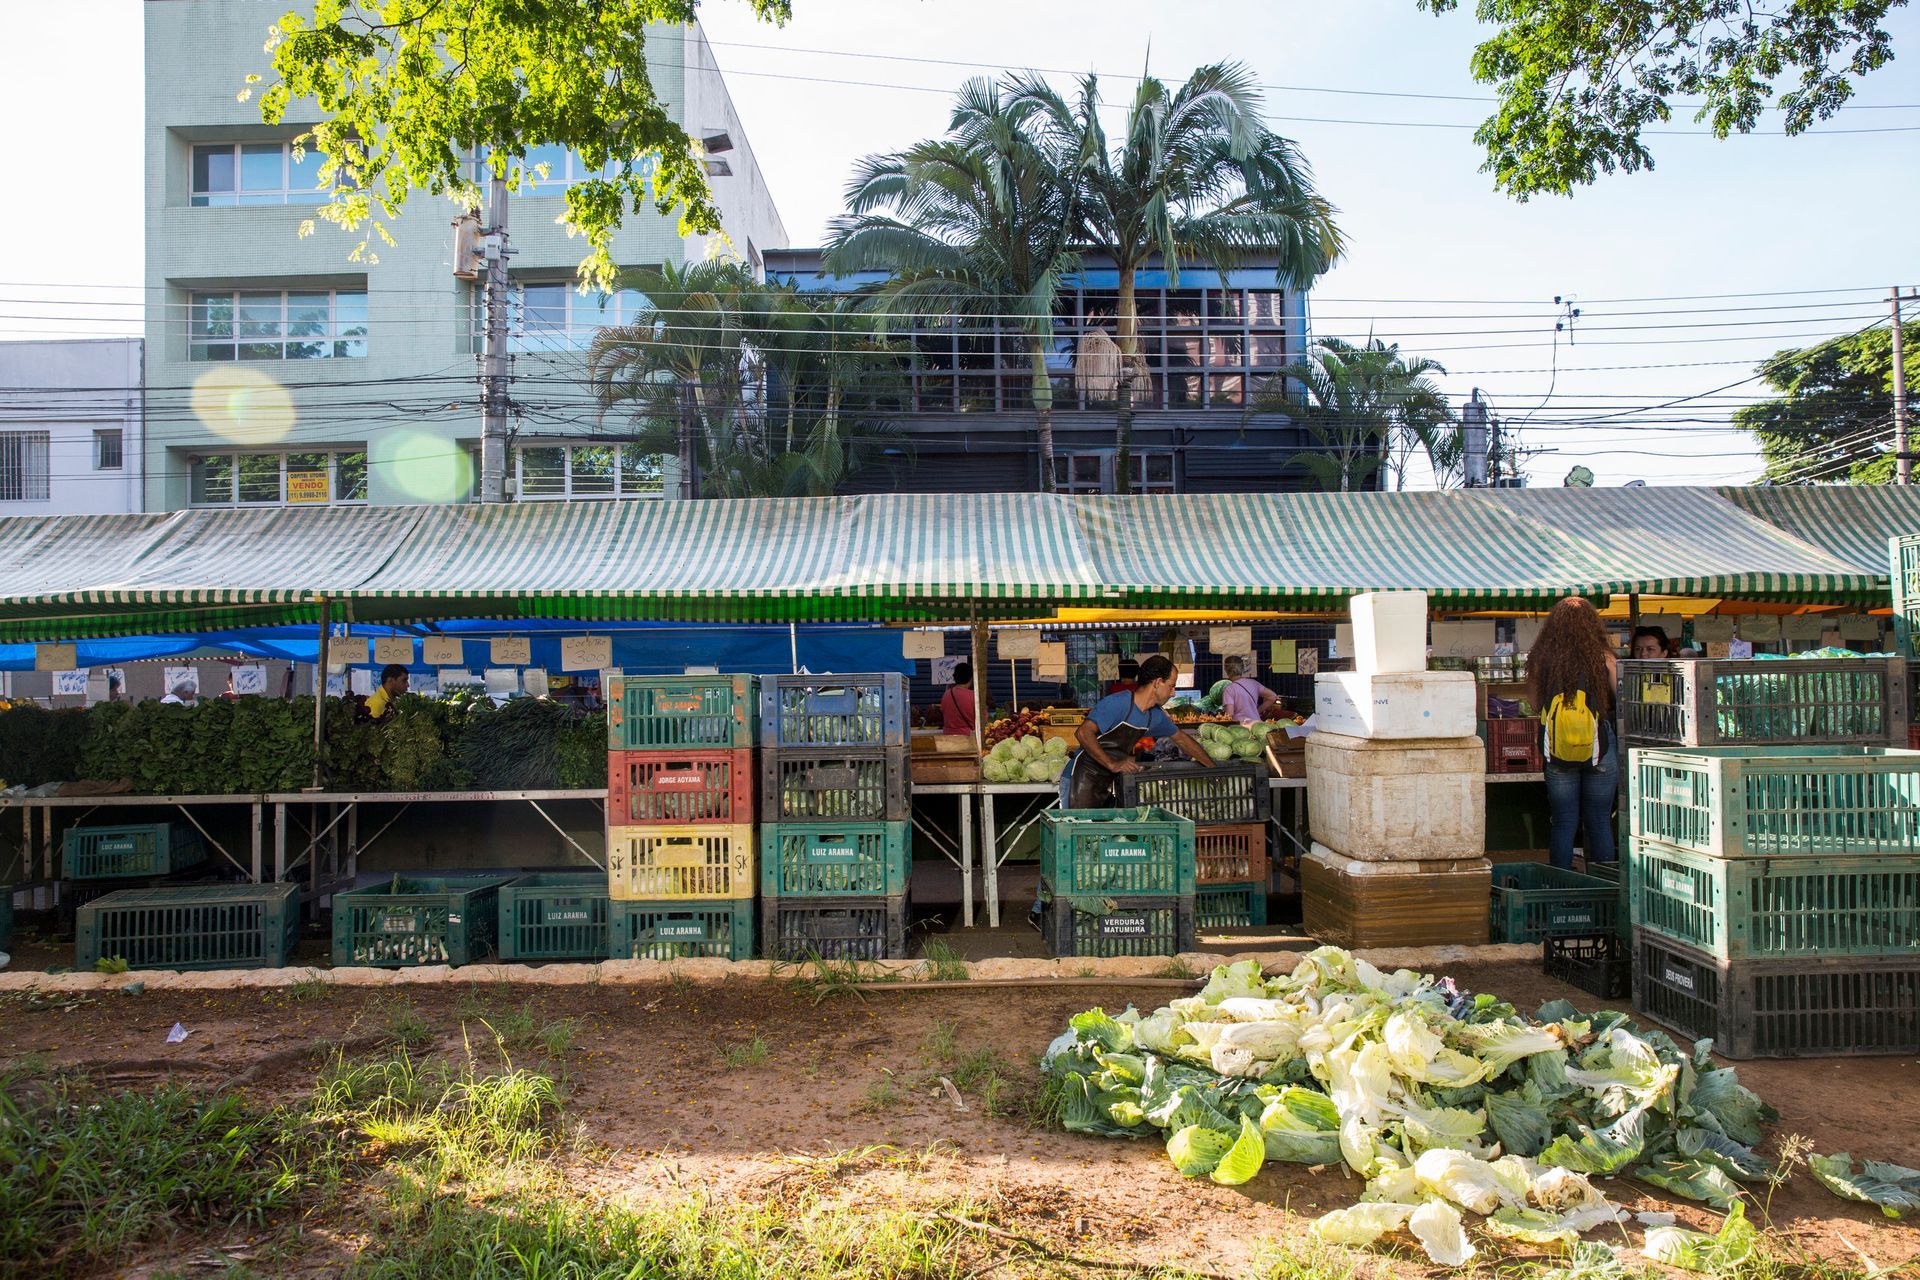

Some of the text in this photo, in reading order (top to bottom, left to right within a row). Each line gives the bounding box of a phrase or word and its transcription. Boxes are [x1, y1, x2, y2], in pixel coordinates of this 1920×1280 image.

[380, 645, 412, 659] 300
[917, 644, 938, 653] 300
[340, 650, 363, 660] 400
[433, 652, 453, 660] 400
[500, 649, 527, 660] 250
[571, 649, 607, 665] 300
[828, 848, 854, 856] ARANHA
[1104, 848, 1147, 857] LUIZ ARANHA
[547, 911, 588, 920] LUIZ ARANHA
[1553, 914, 1591, 924] LUIZ ARANHA
[1104, 918, 1145, 926] VERDURAS
[660, 926, 702, 936] LUIZ ARANHA
[1665, 968, 1675, 982] DEUS
